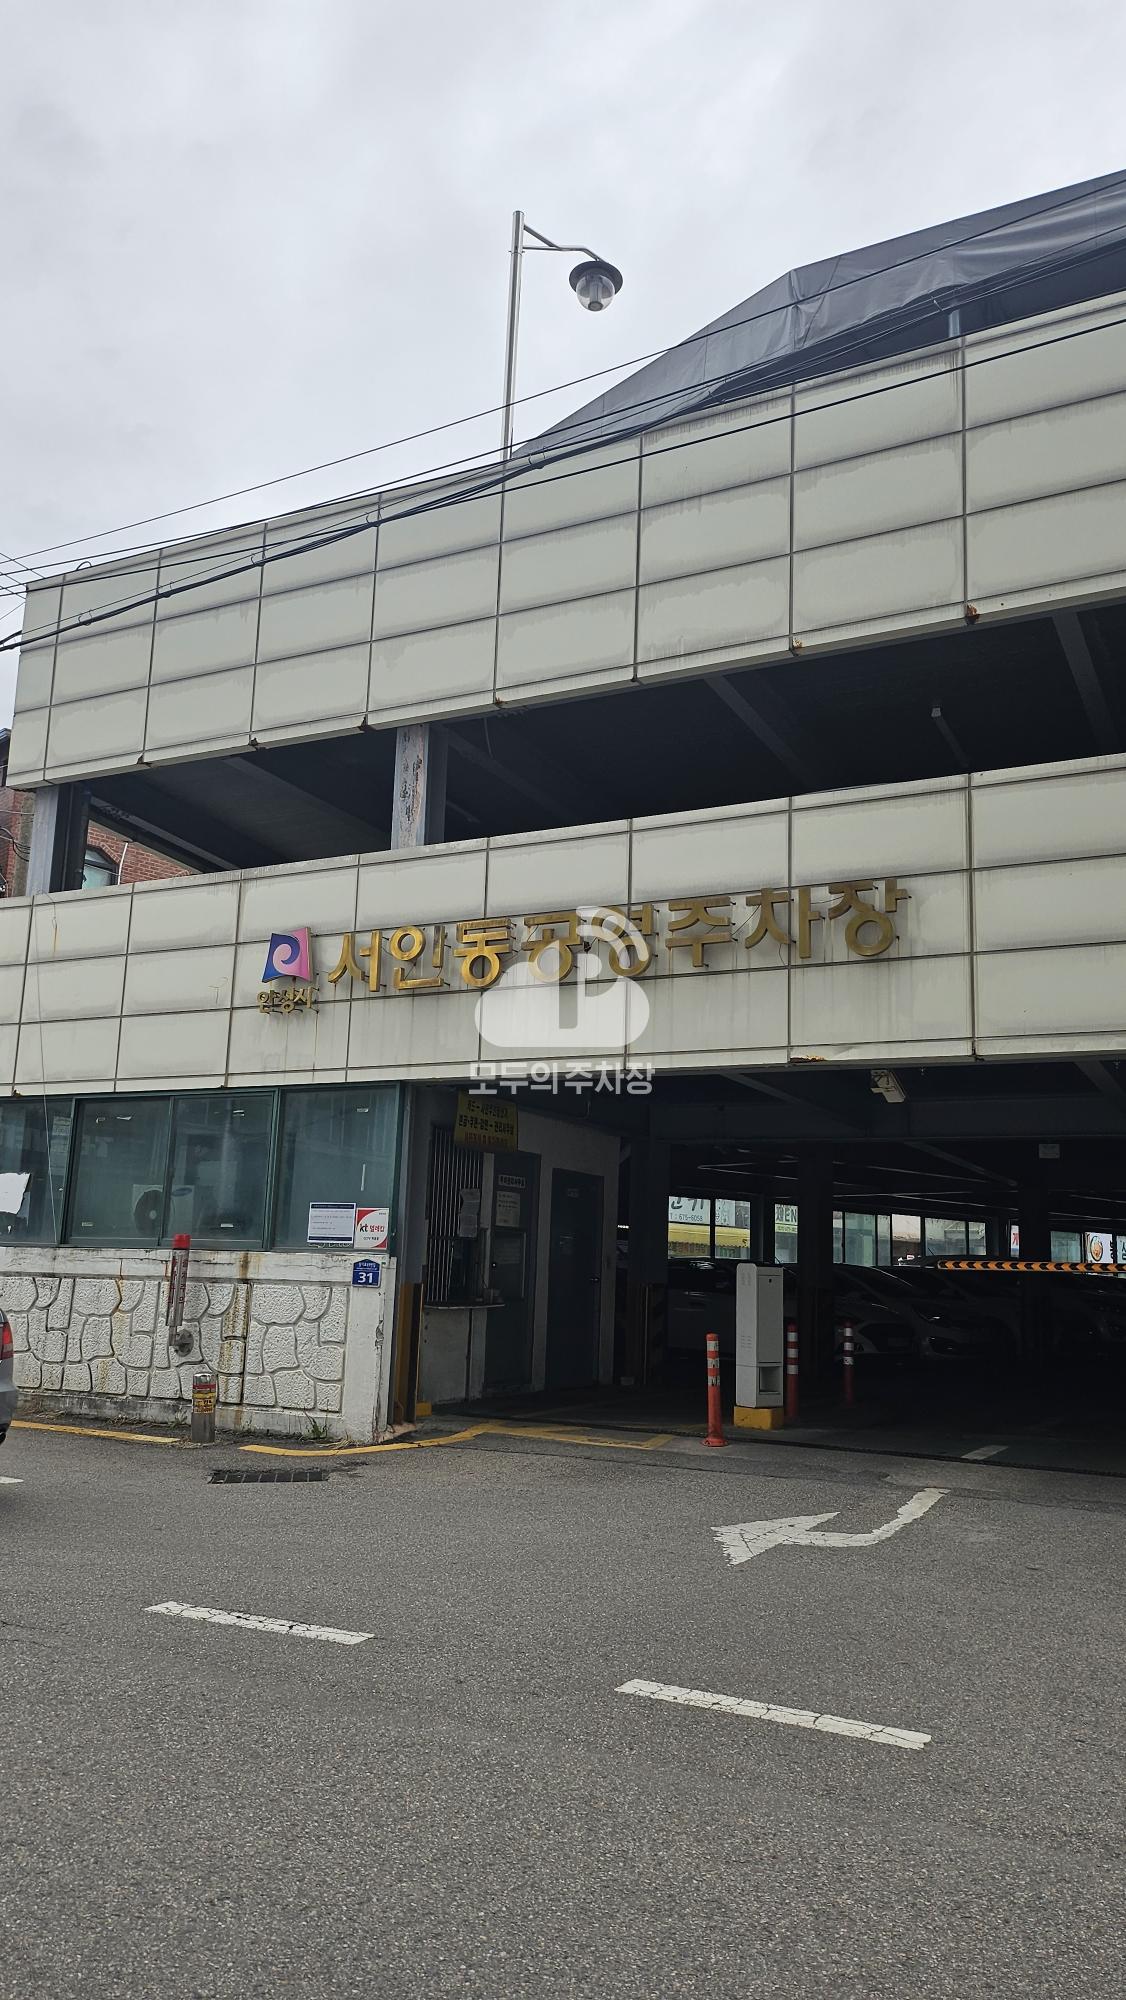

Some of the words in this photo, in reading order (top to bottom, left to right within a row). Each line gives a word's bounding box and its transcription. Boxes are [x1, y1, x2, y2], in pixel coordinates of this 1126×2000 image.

[328, 878, 908, 992] 서인동공영주차장
[257, 986, 313, 1014] 안성시
[359, 1223, 369, 1233] kt
[357, 1272, 373, 1284] 31
